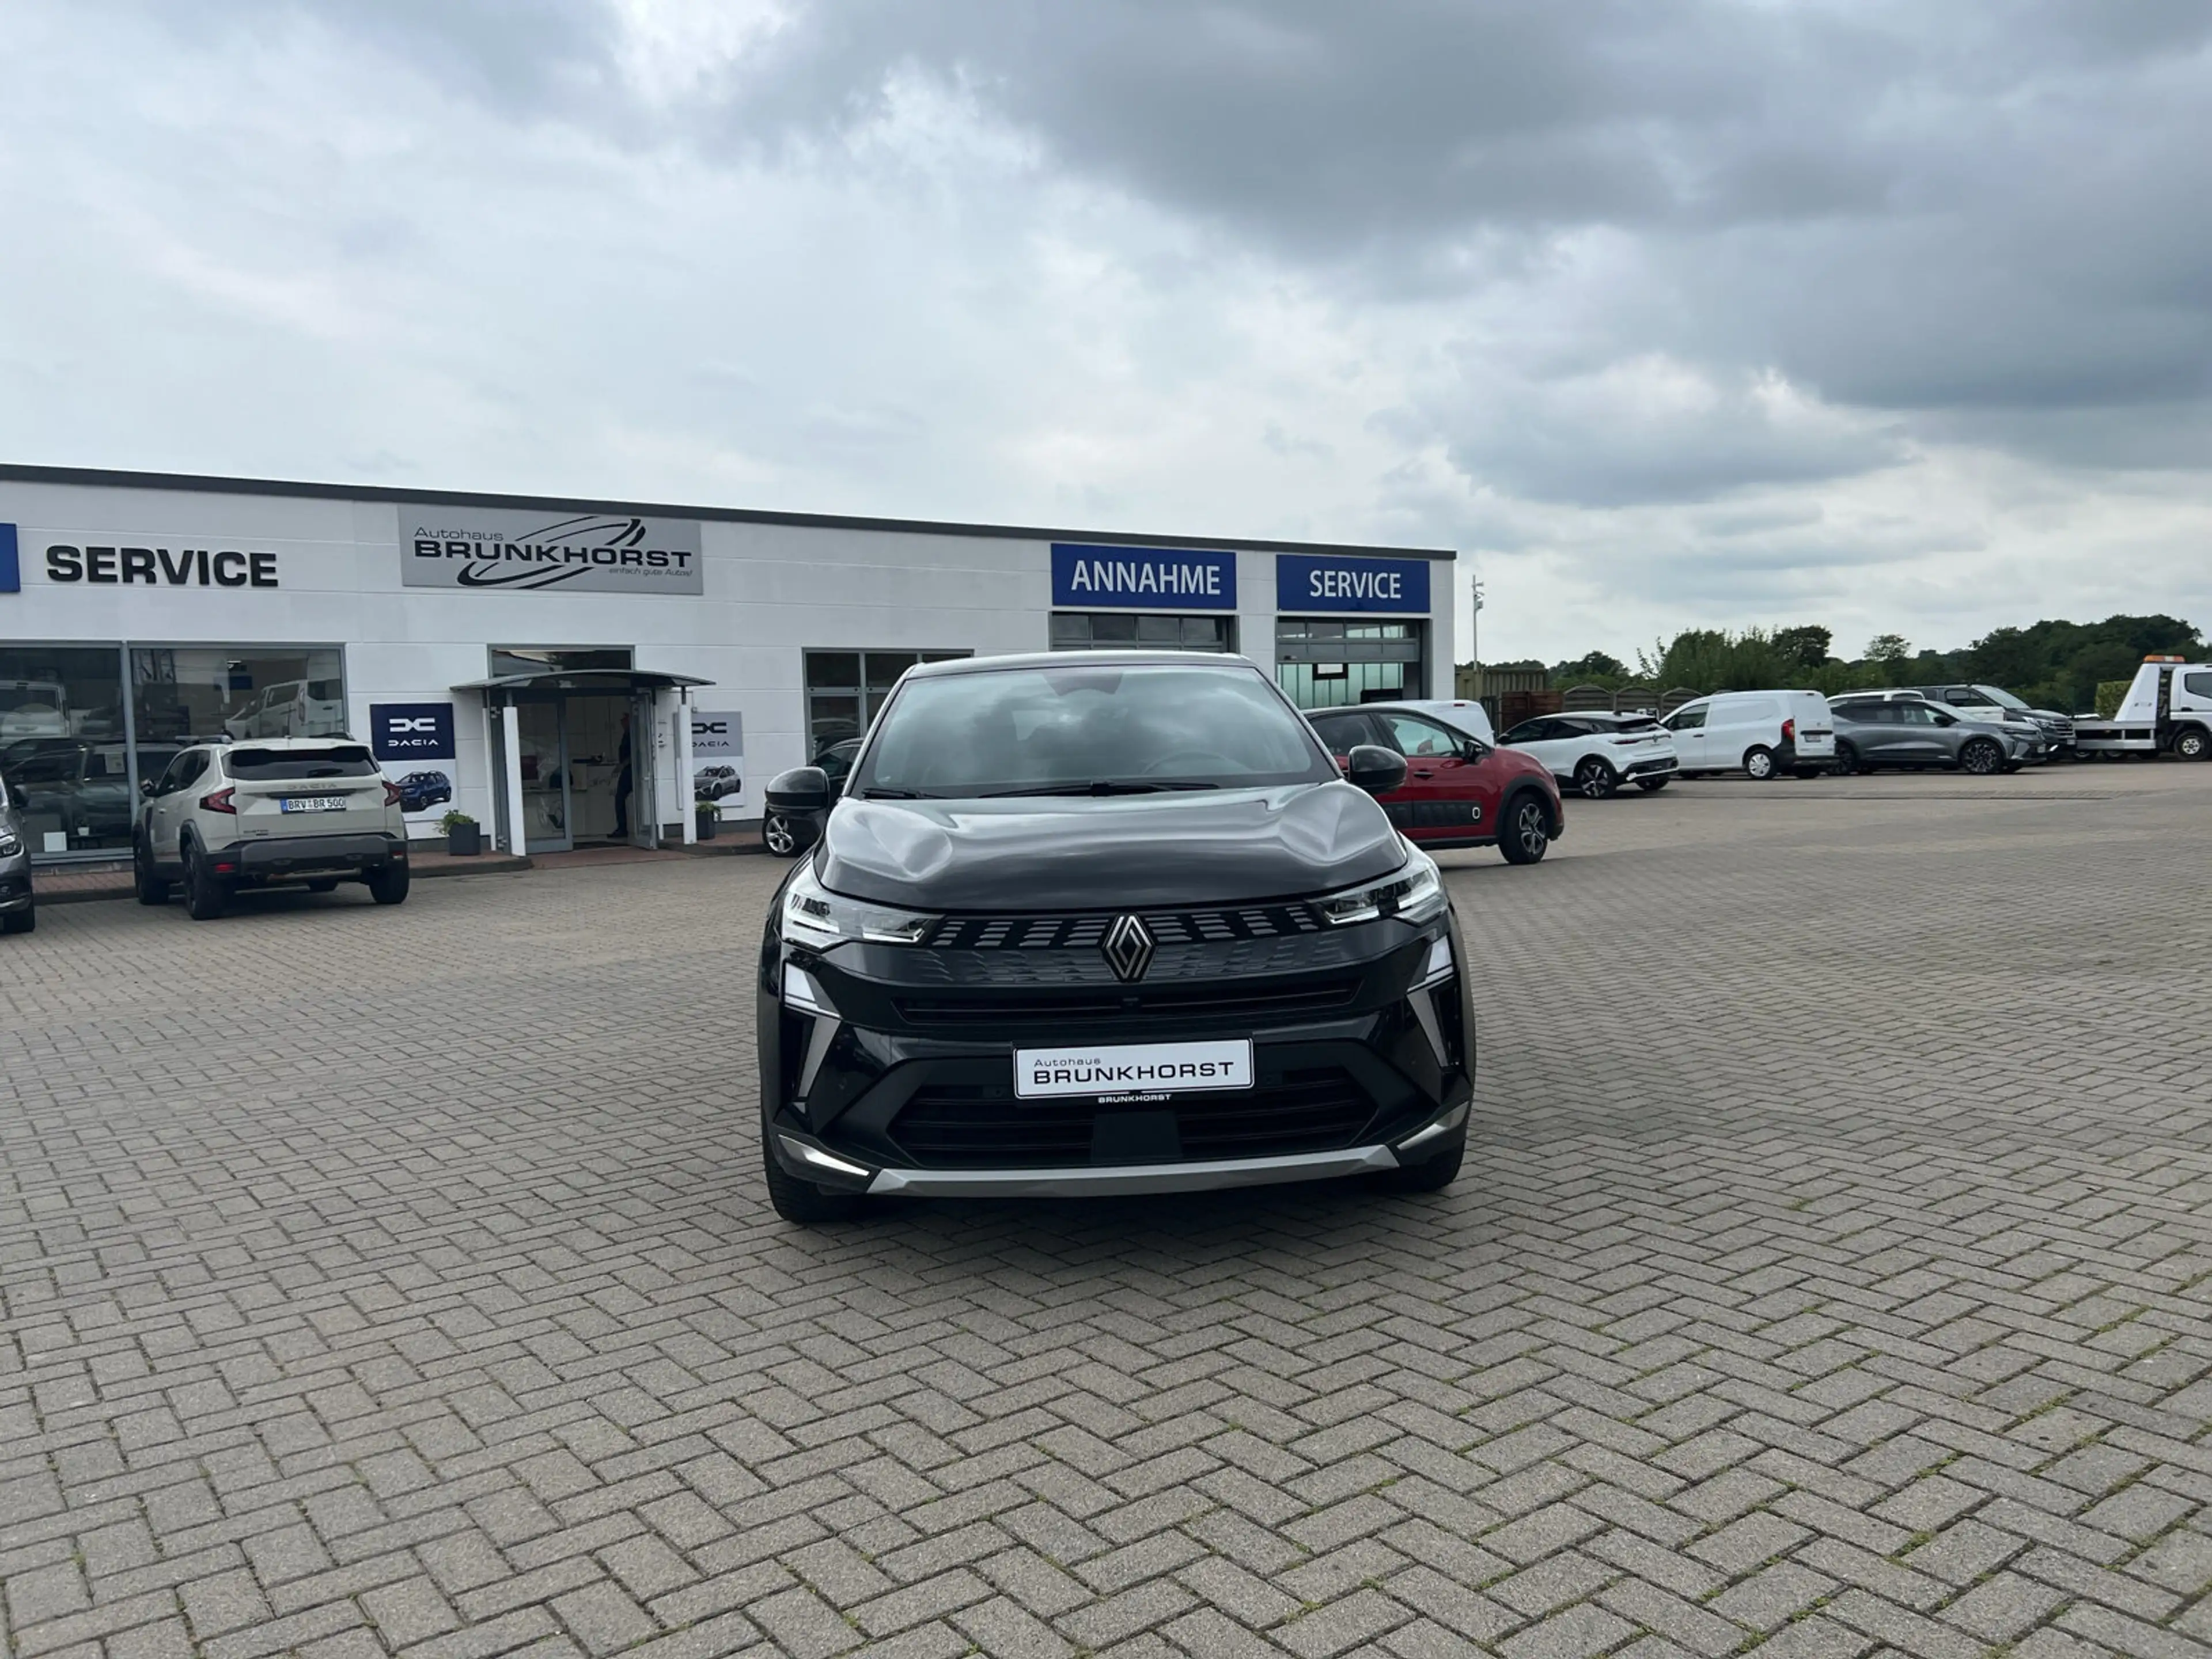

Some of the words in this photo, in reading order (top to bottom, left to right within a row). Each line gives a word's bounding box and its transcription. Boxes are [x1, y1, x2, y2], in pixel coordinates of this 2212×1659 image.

[414, 527, 504, 541] Autohaus
[414, 540, 692, 567] BRUNKHORST
[46, 545, 278, 587] SERVICE
[608, 567, 641, 575] einfach
[1071, 560, 1221, 595] ANNAHME
[1309, 570, 1402, 599] SERVICE
[288, 800, 306, 810] BRV
[313, 799, 325, 808] BR
[327, 797, 344, 807] 500
[1034, 1058, 1101, 1067] Autohaus
[1034, 1062, 1234, 1085] BRUNKHORST
[1098, 1093, 1172, 1104] BRUNKHORST
